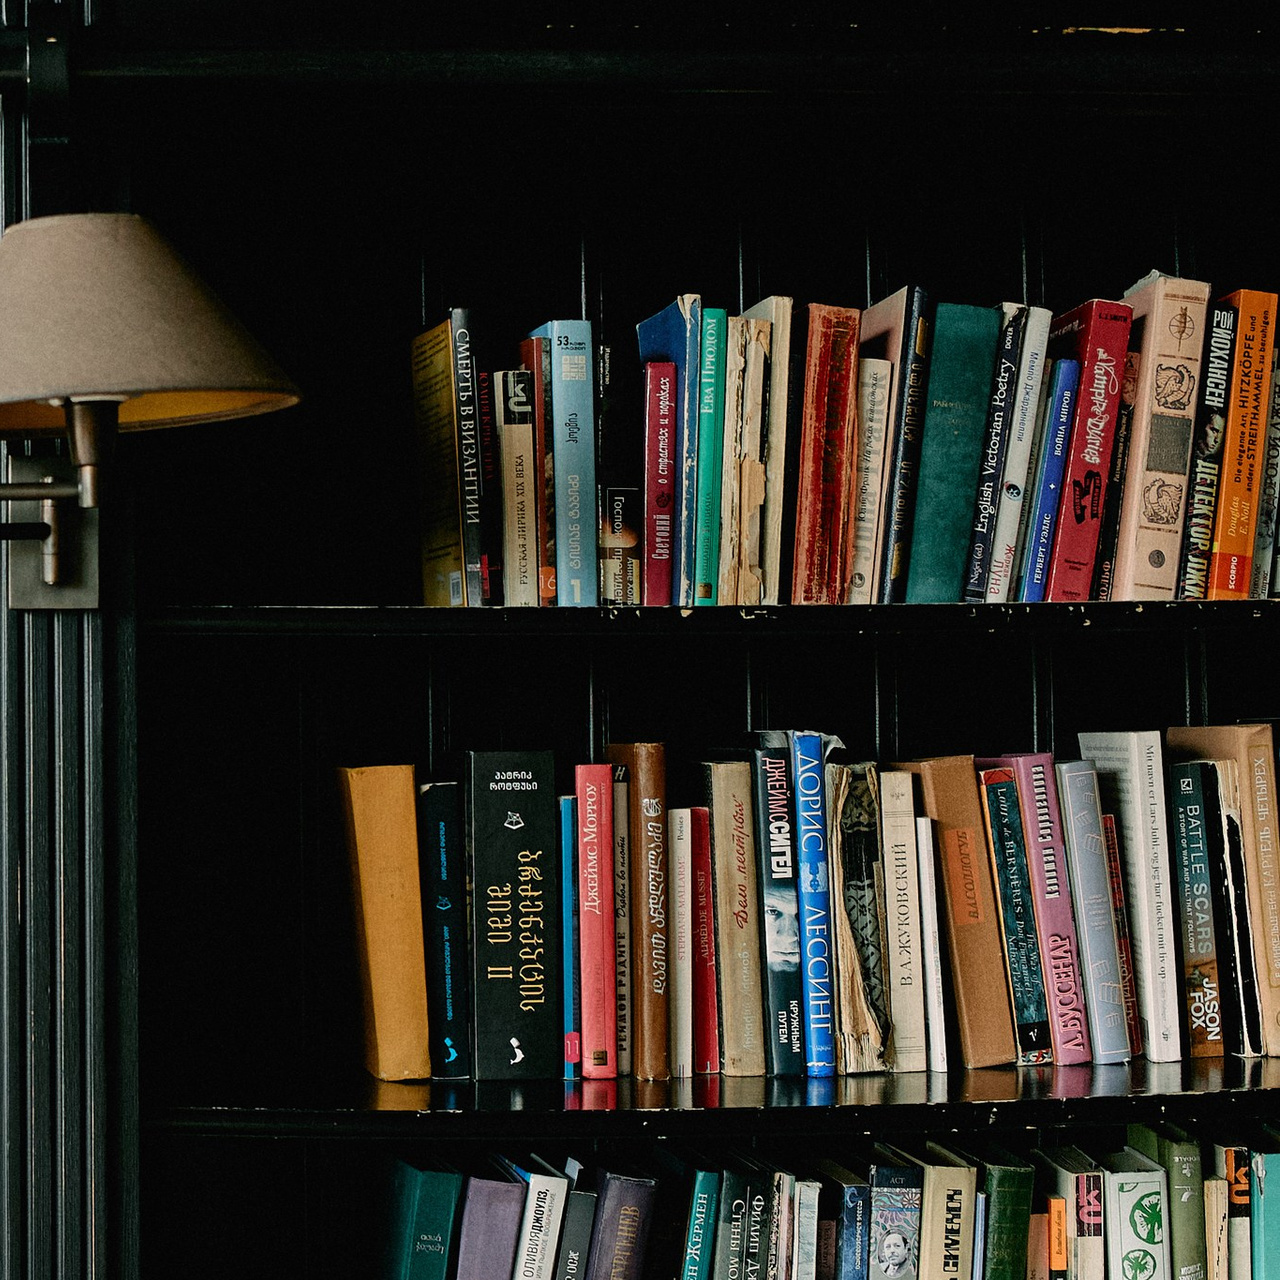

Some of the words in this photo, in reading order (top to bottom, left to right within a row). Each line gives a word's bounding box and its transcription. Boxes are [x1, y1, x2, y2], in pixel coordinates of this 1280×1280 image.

[1212, 309, 1235, 328] РОЙ
[452, 327, 473, 401] СМЕРТЬ
[993, 357, 1015, 407] Poetry
[1203, 327, 1233, 408] ЙОХАНСЕН
[459, 404, 473, 416] В
[514, 454, 524, 478] ВЕКА
[983, 410, 1004, 476] Victorian
[459, 419, 481, 524] ВИЗАНТИИ
[516, 480, 525, 497] XIX
[516, 499, 526, 540] ЛИРИКА
[975, 481, 998, 534] English
[1039, 512, 1052, 543] УЭЛЛС
[1186, 459, 1218, 553] ДЕТЕКТОР
[1226, 495, 1242, 536] Douglas
[518, 543, 528, 584] РУССКАЯ
[970, 560, 982, 583] Negri
[973, 542, 985, 559] (ed.)
[1033, 545, 1047, 583] ГЕРБЕРТ
[1183, 554, 1207, 598] ЛЖИ
[584, 782, 598, 842] МОРРОУ
[761, 757, 788, 822] ДЖЕЙМС
[797, 751, 823, 851] ДОРИС
[1030, 764, 1052, 842] Сорвиголова
[1253, 757, 1269, 820] ЧЕТЫРЕХ
[768, 821, 792, 878] СИГЕЛ
[1186, 804, 1205, 874] BATTLE
[1257, 825, 1275, 886] КАРТЕЛЬ
[583, 845, 601, 914] ДЖЕЙМС
[1040, 847, 1060, 899] Капитан
[1193, 882, 1213, 954] SCARS
[805, 903, 831, 1035] ЛЕССИНГ
[1047, 932, 1080, 1032] БУССЕНАР
[777, 1011, 788, 1042] ПУТЕМ
[788, 1000, 800, 1053] КРУЖНЫМ
[1189, 991, 1205, 1029] FOX
[1201, 977, 1221, 1040] JASON
[1063, 1033, 1083, 1052] Л.
[531, 1186, 550, 1232] ДЖОУЛЗ,
[729, 1198, 745, 1250] СТЕНЫ
[746, 1194, 764, 1253] ФИЛИП
[941, 1188, 961, 1272] СИМЕНОН
[522, 1230, 541, 1278] ОЛИВИЯ
